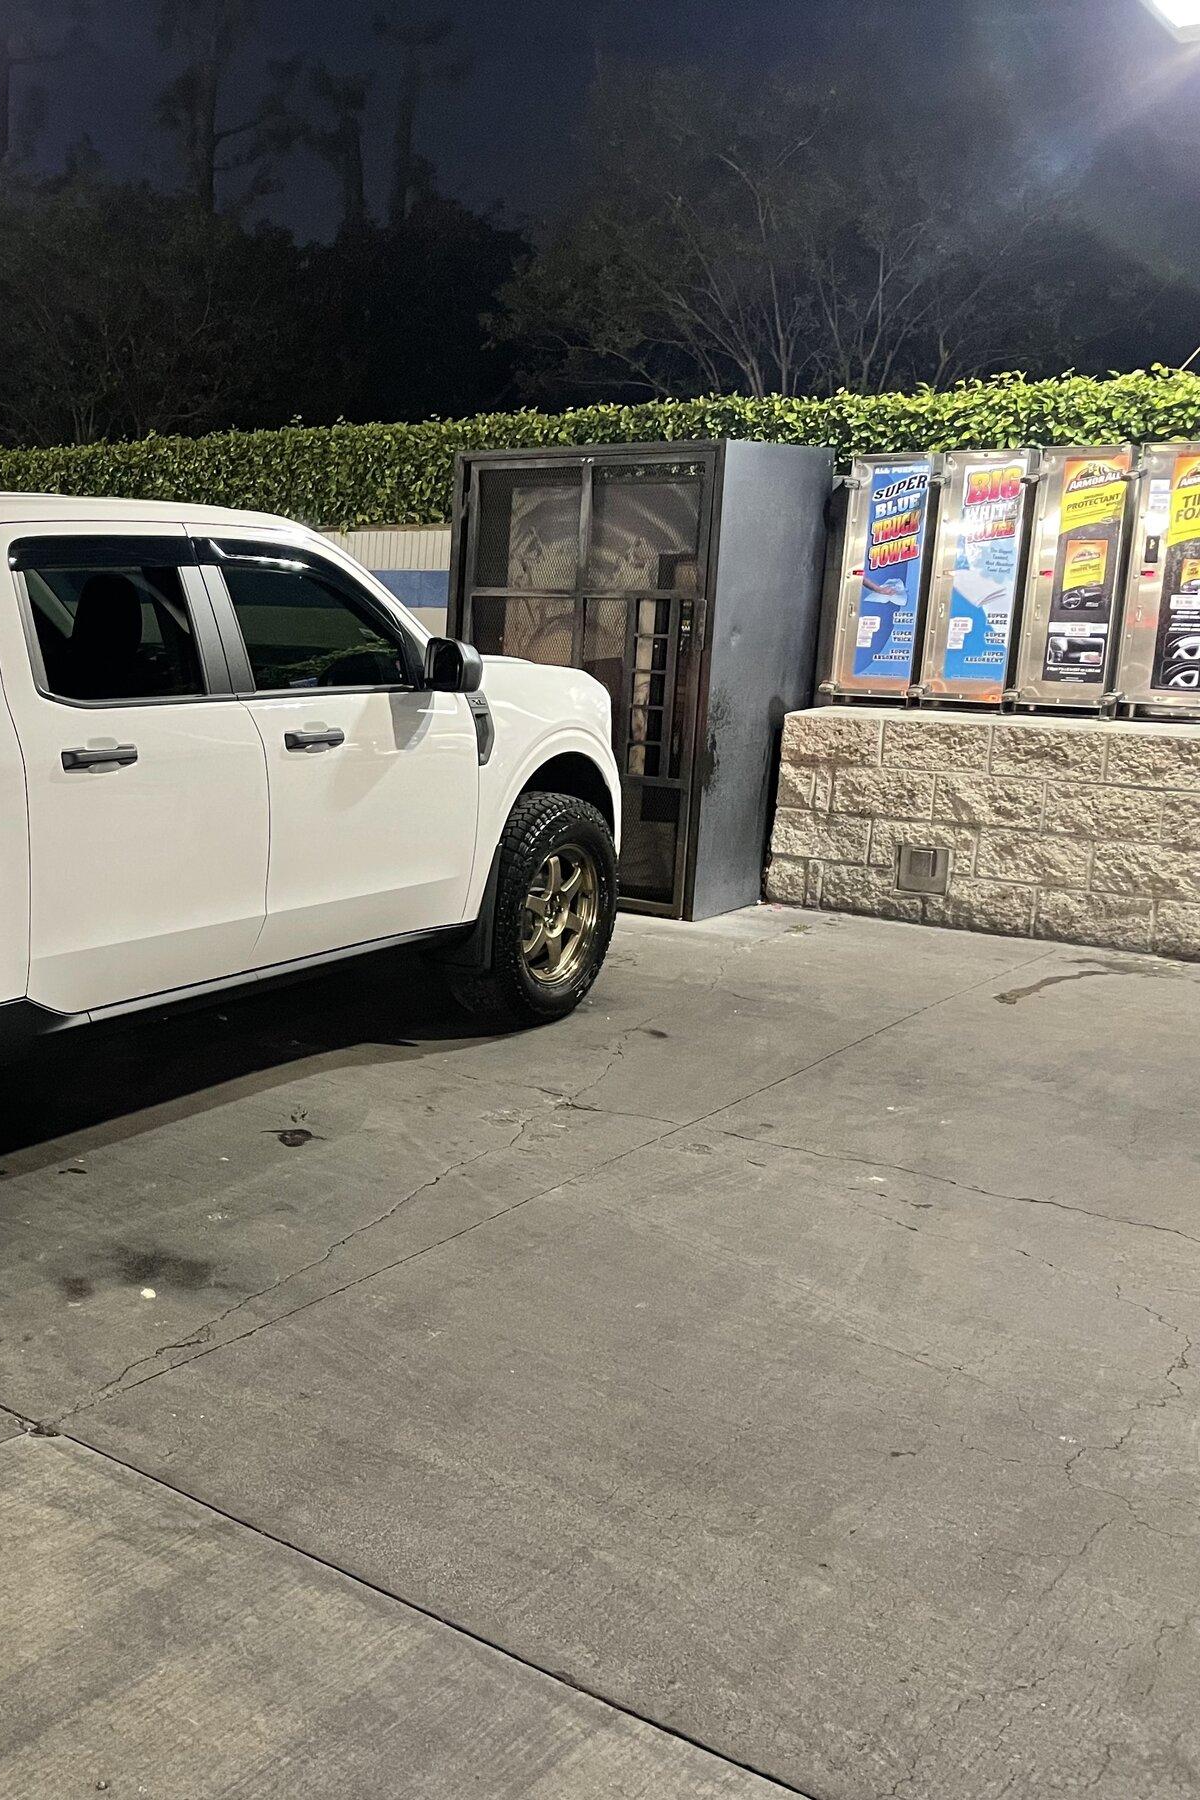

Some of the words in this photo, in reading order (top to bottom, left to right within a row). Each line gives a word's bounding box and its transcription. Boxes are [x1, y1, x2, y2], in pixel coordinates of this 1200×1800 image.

[874, 474, 928, 499] SUPER
[965, 467, 1022, 505] BIG
[875, 493, 921, 518] BLUE
[1066, 493, 1121, 511] PROTECTANT
[872, 510, 920, 543] TRUCK
[869, 536, 919, 569] TOWEL
